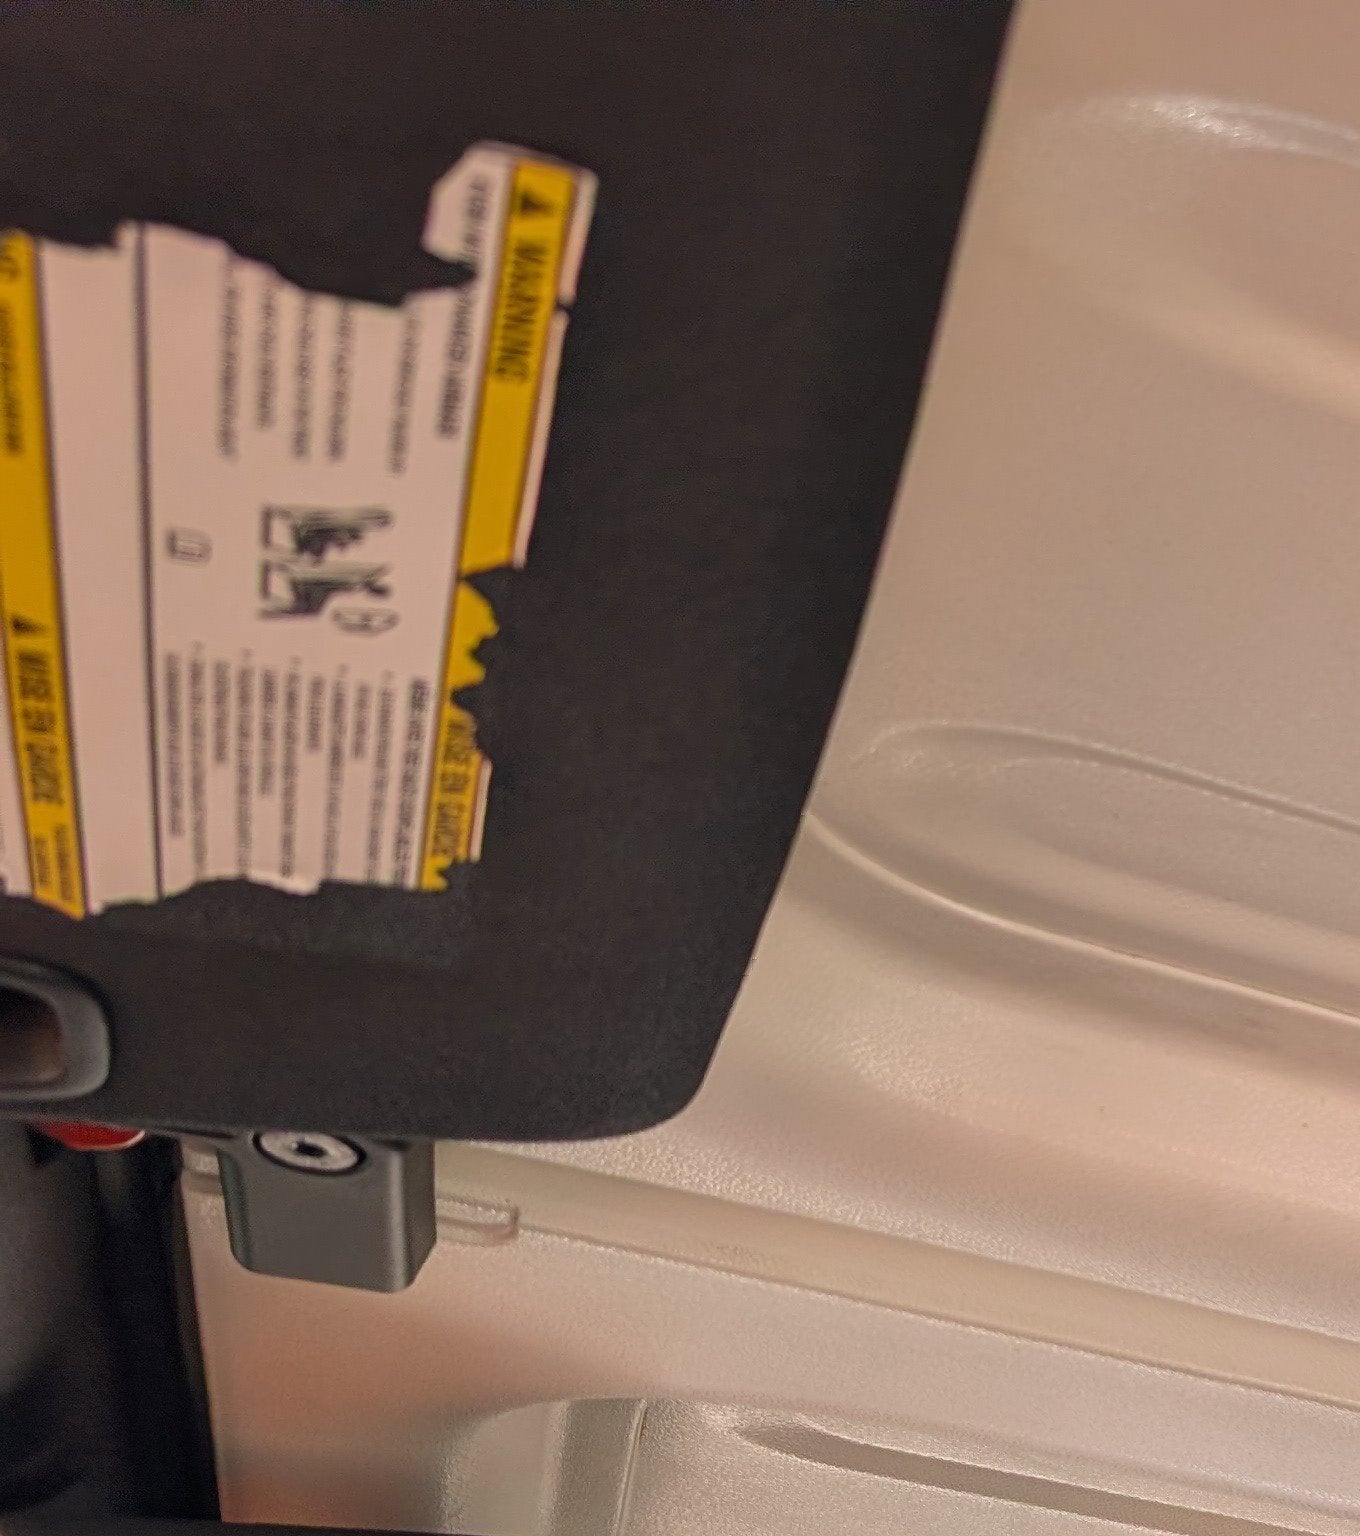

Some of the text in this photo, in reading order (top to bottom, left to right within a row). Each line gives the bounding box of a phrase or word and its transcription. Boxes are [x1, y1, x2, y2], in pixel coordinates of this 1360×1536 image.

[496, 243, 551, 384] WARNING
[17, 652, 53, 702] MISE
[23, 708, 56, 736] EN
[28, 743, 63, 806] GARDE
